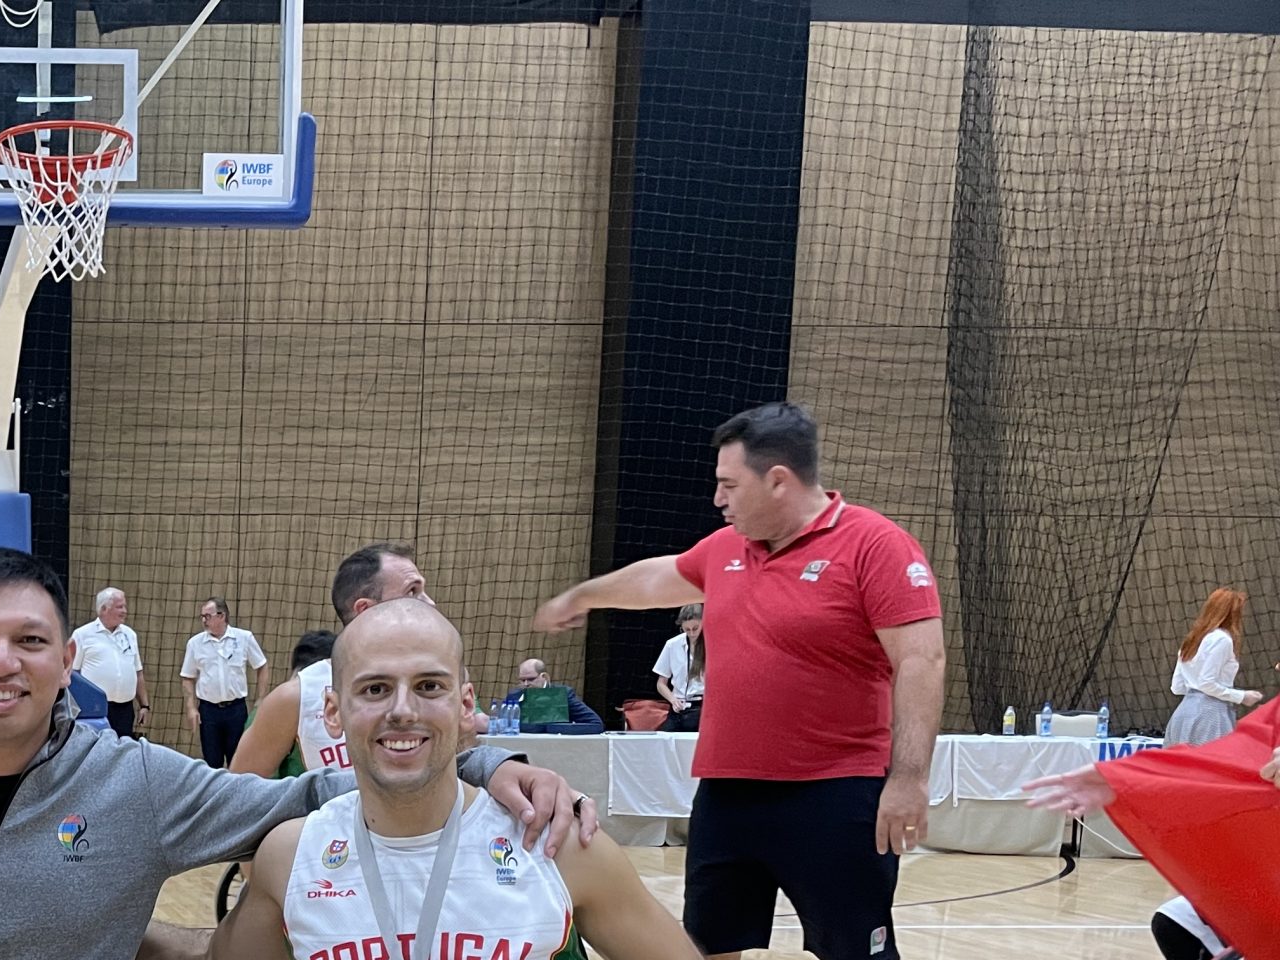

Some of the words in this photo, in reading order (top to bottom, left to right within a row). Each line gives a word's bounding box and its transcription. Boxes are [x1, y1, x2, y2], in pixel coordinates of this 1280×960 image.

[242, 163, 273, 174] IWBF
[242, 176, 273, 187] Europe
[307, 889, 357, 899] DHIKA
